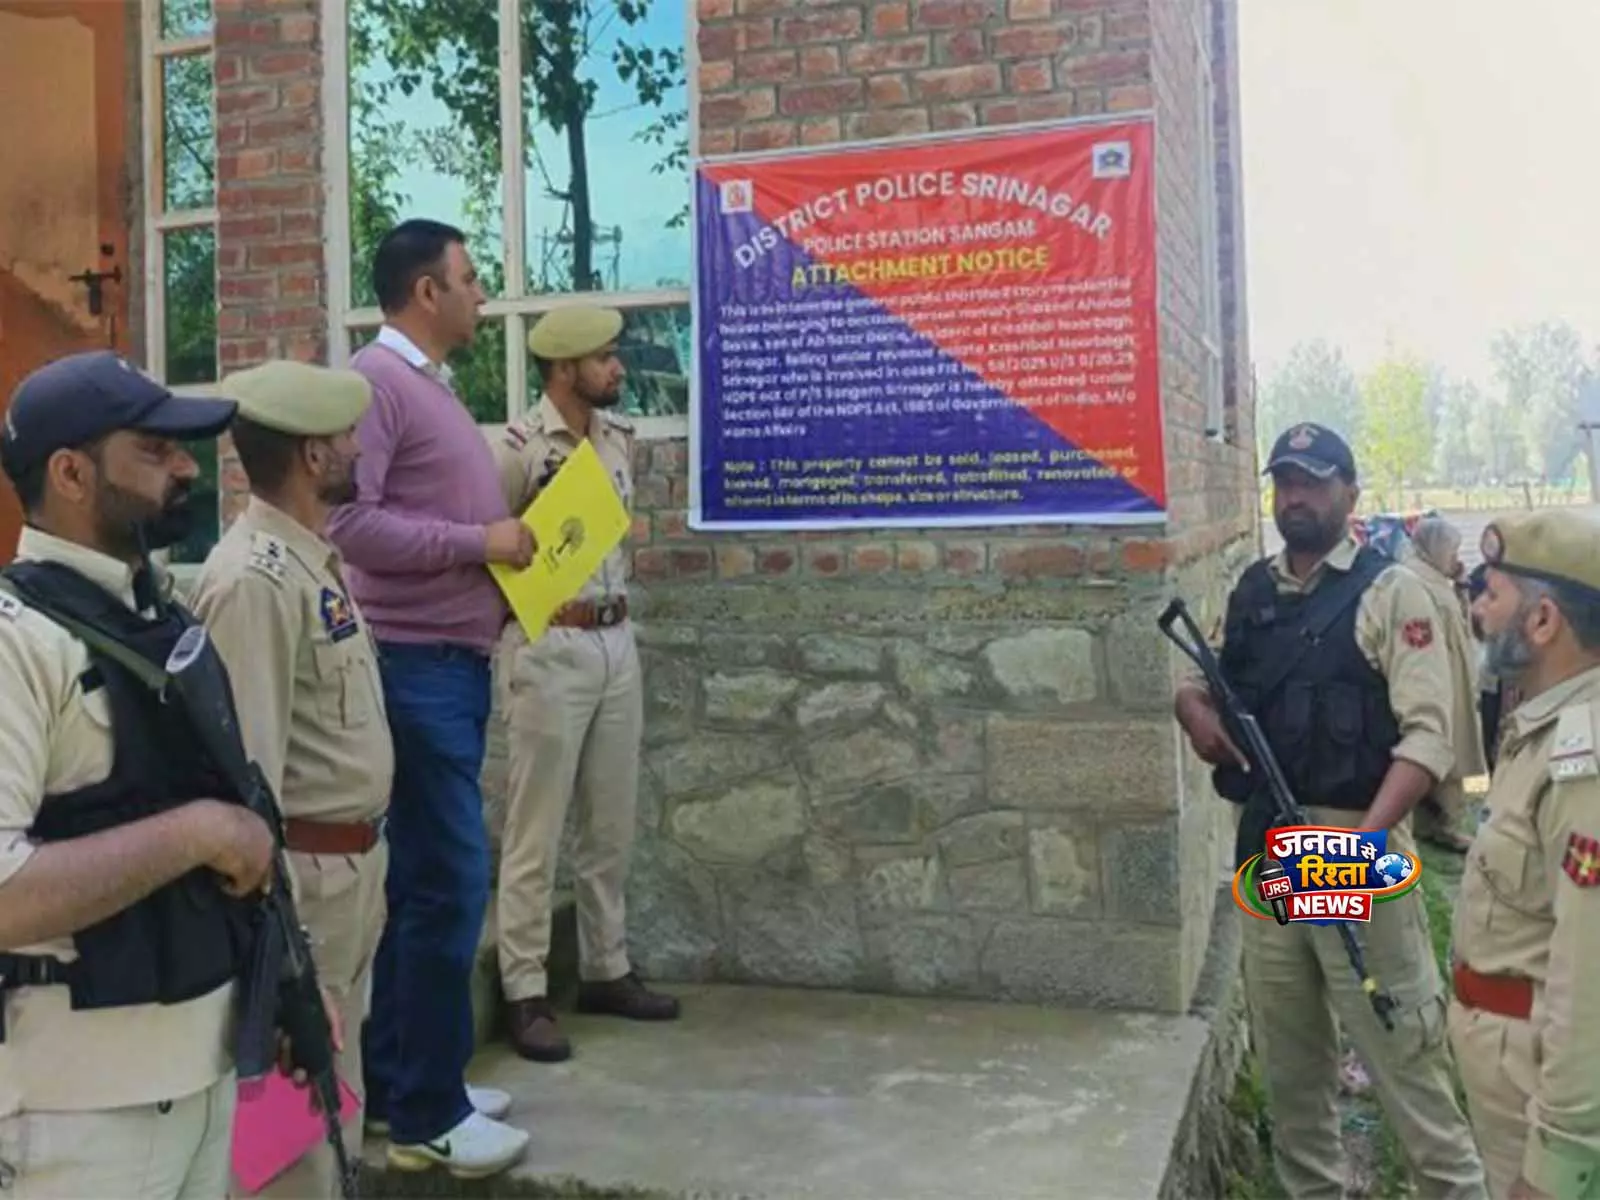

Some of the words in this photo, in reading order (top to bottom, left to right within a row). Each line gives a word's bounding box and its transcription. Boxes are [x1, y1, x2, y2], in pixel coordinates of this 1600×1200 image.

[734, 186, 849, 269] DISTRICT
[855, 170, 955, 206] POLICE
[961, 172, 1114, 238] SRINAGAR
[803, 233, 862, 254] POLICE
[865, 225, 945, 249] STATION
[950, 219, 1036, 240] SANGAM
[791, 256, 951, 287] ATTACHMENT
[957, 247, 1049, 271] NOTICE
[720, 303, 746, 317] This
